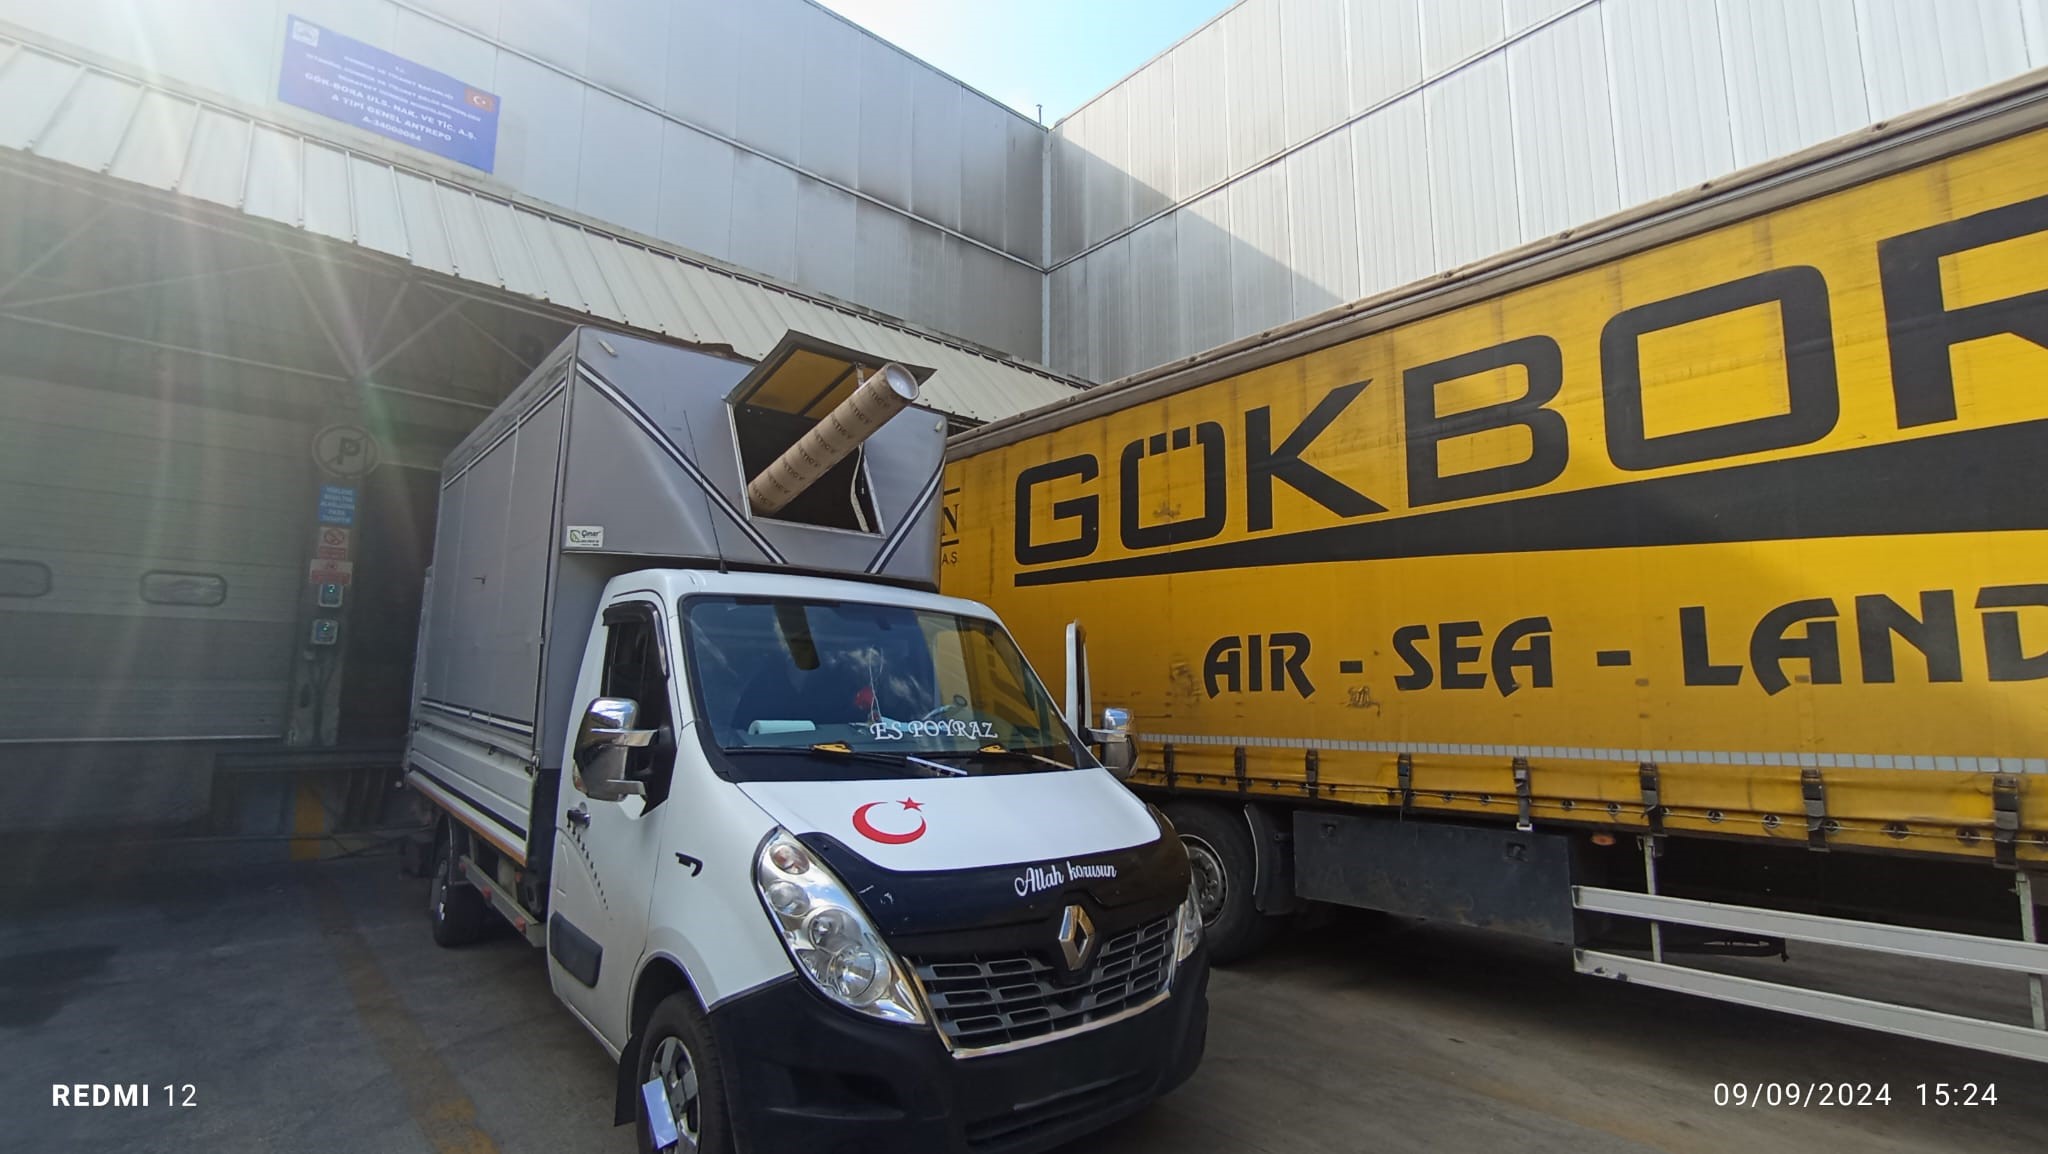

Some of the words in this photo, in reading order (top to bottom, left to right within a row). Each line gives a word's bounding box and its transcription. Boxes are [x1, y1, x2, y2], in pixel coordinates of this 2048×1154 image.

[404, 119, 452, 142] ANTREPO
[1203, 632, 1316, 699] AIR
[1392, 616, 1553, 698] SEA
[870, 722, 904, 740] ES
[907, 719, 998, 740] POYRAZ
[1014, 864, 1065, 897] Allah
[1066, 860, 1117, 881] korusun
